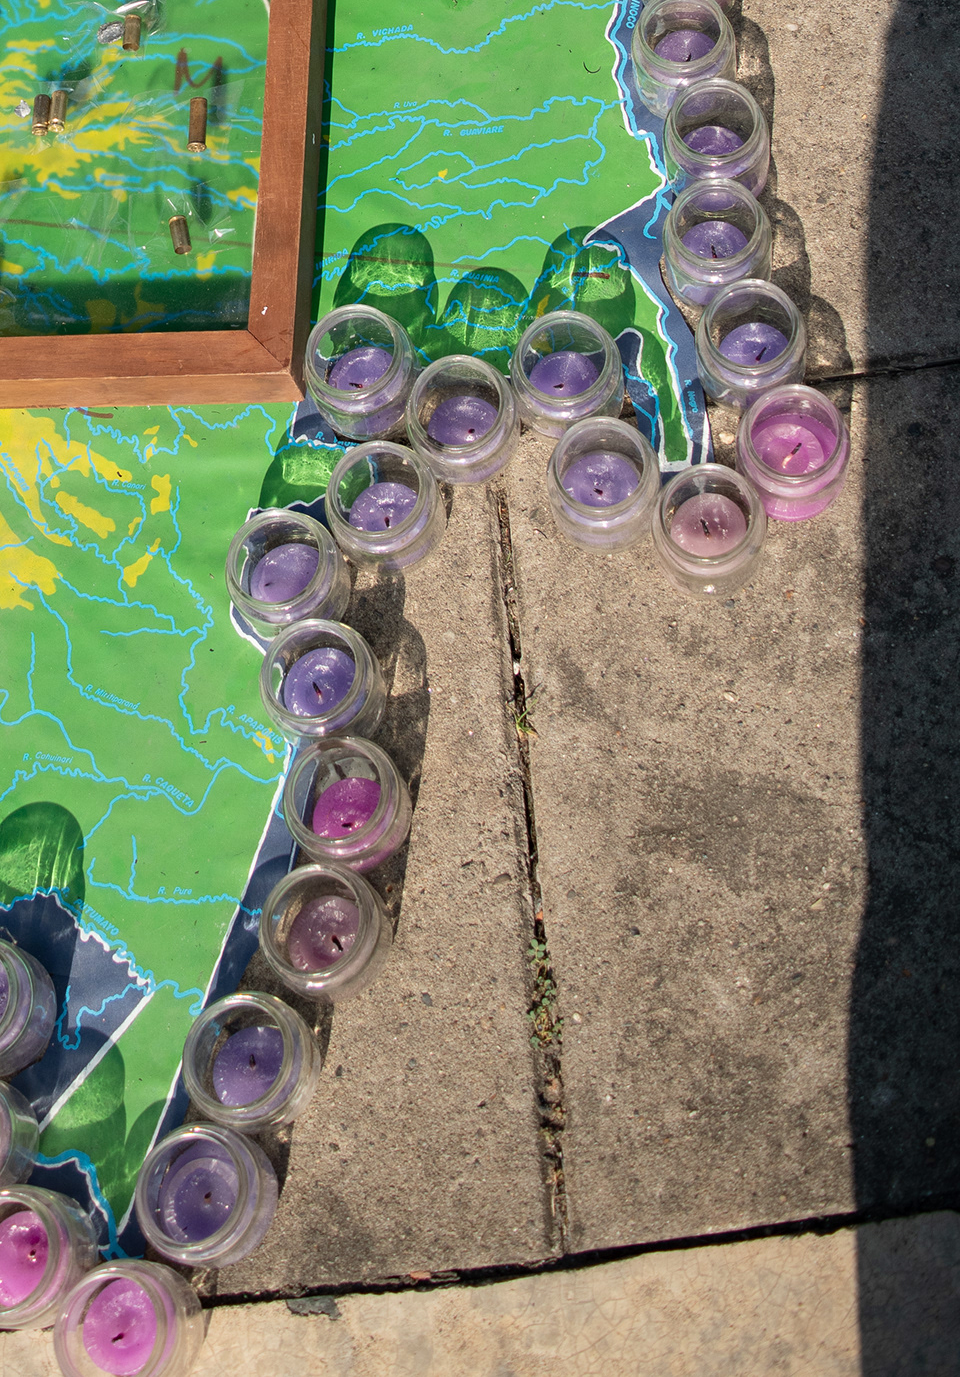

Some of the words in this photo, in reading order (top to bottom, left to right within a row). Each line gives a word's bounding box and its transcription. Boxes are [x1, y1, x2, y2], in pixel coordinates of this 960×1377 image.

[356, 32, 366, 40] R.
[372, 24, 414, 37] VICHADA
[443, 129, 453, 137] R.
[460, 125, 504, 137] GUAVIARE
[153, 776, 196, 809] CAQUETA
[158, 886, 167, 895] R.
